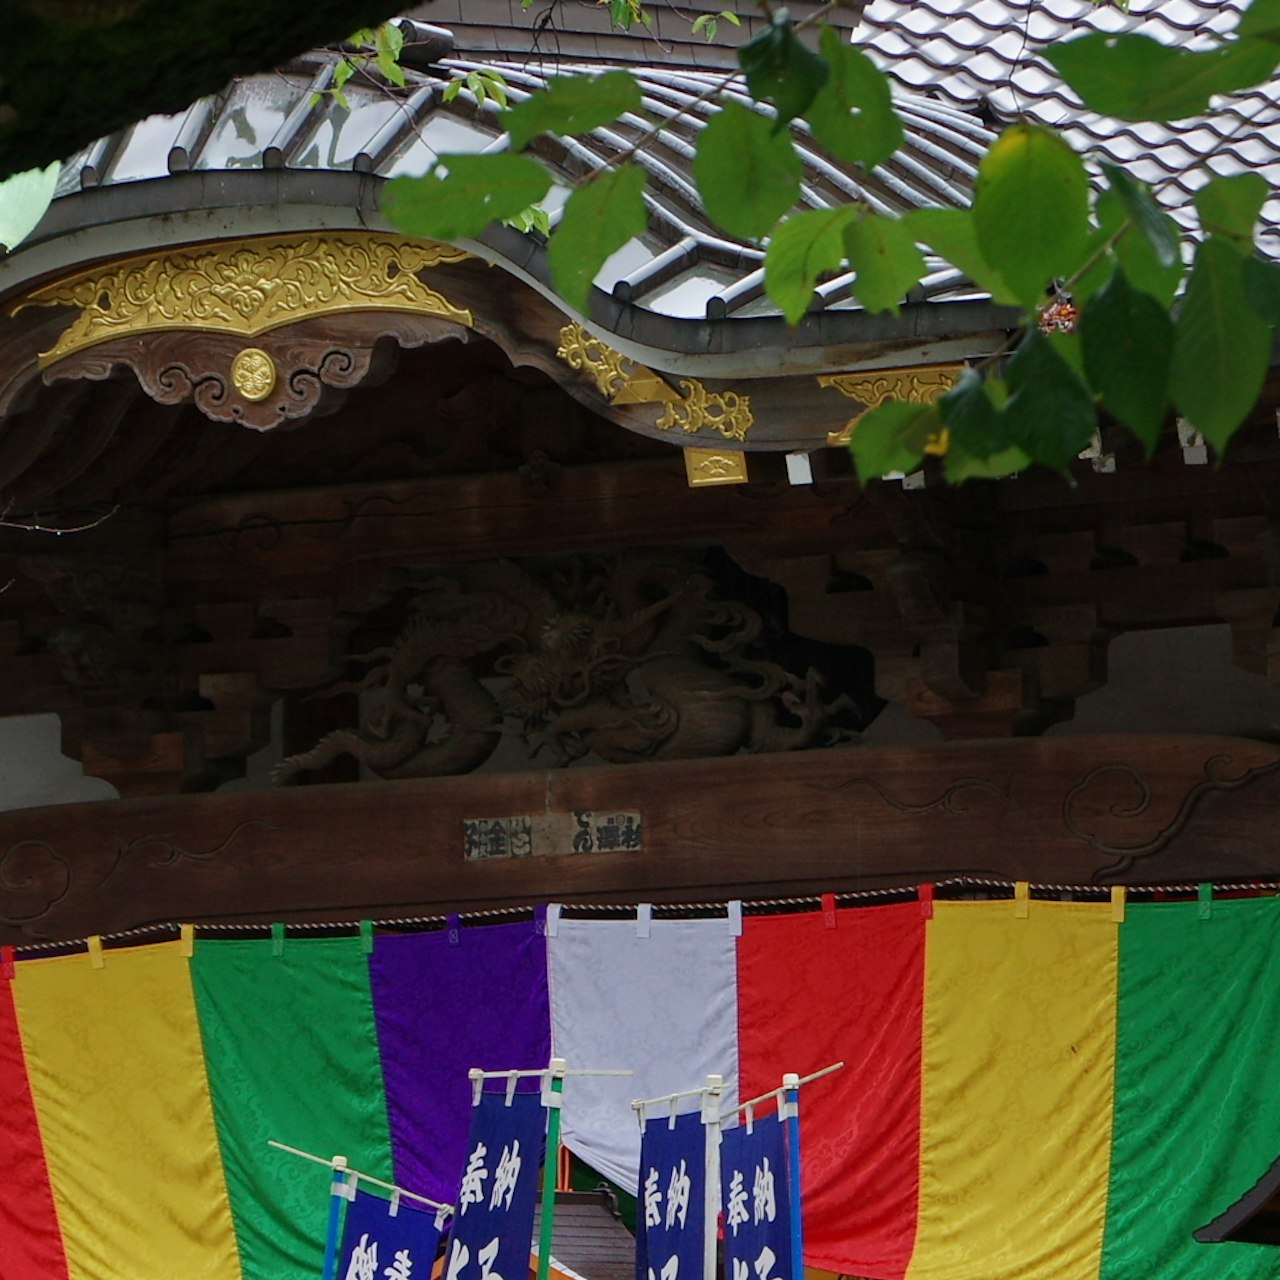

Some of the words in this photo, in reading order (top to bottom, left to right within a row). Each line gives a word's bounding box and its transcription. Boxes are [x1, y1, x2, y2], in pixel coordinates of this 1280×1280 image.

[460, 1139, 521, 1216] 奉納
[644, 1158, 691, 1232] 奉納
[726, 1157, 777, 1237] 奉納
